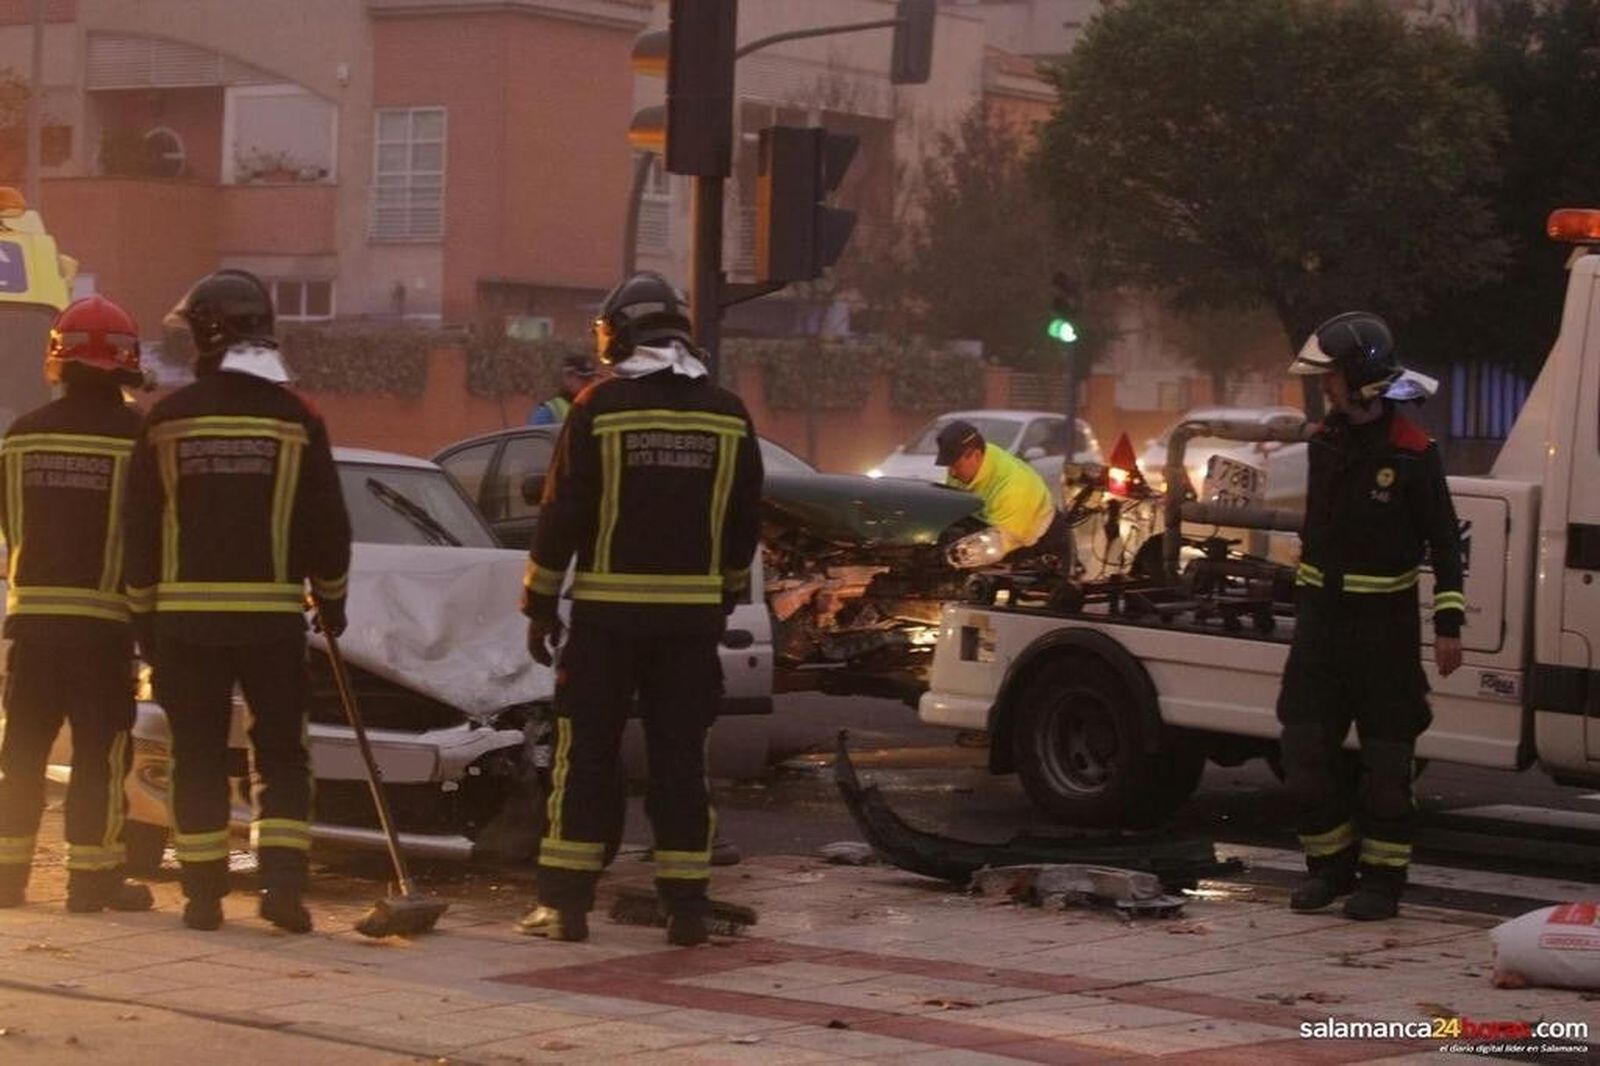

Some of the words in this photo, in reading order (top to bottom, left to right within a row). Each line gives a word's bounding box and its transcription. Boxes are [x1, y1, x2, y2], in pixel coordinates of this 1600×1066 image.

[180, 439, 278, 458] BOMBEROS
[625, 431, 717, 451] BOMBEROS
[23, 452, 112, 474] BOMBEROS
